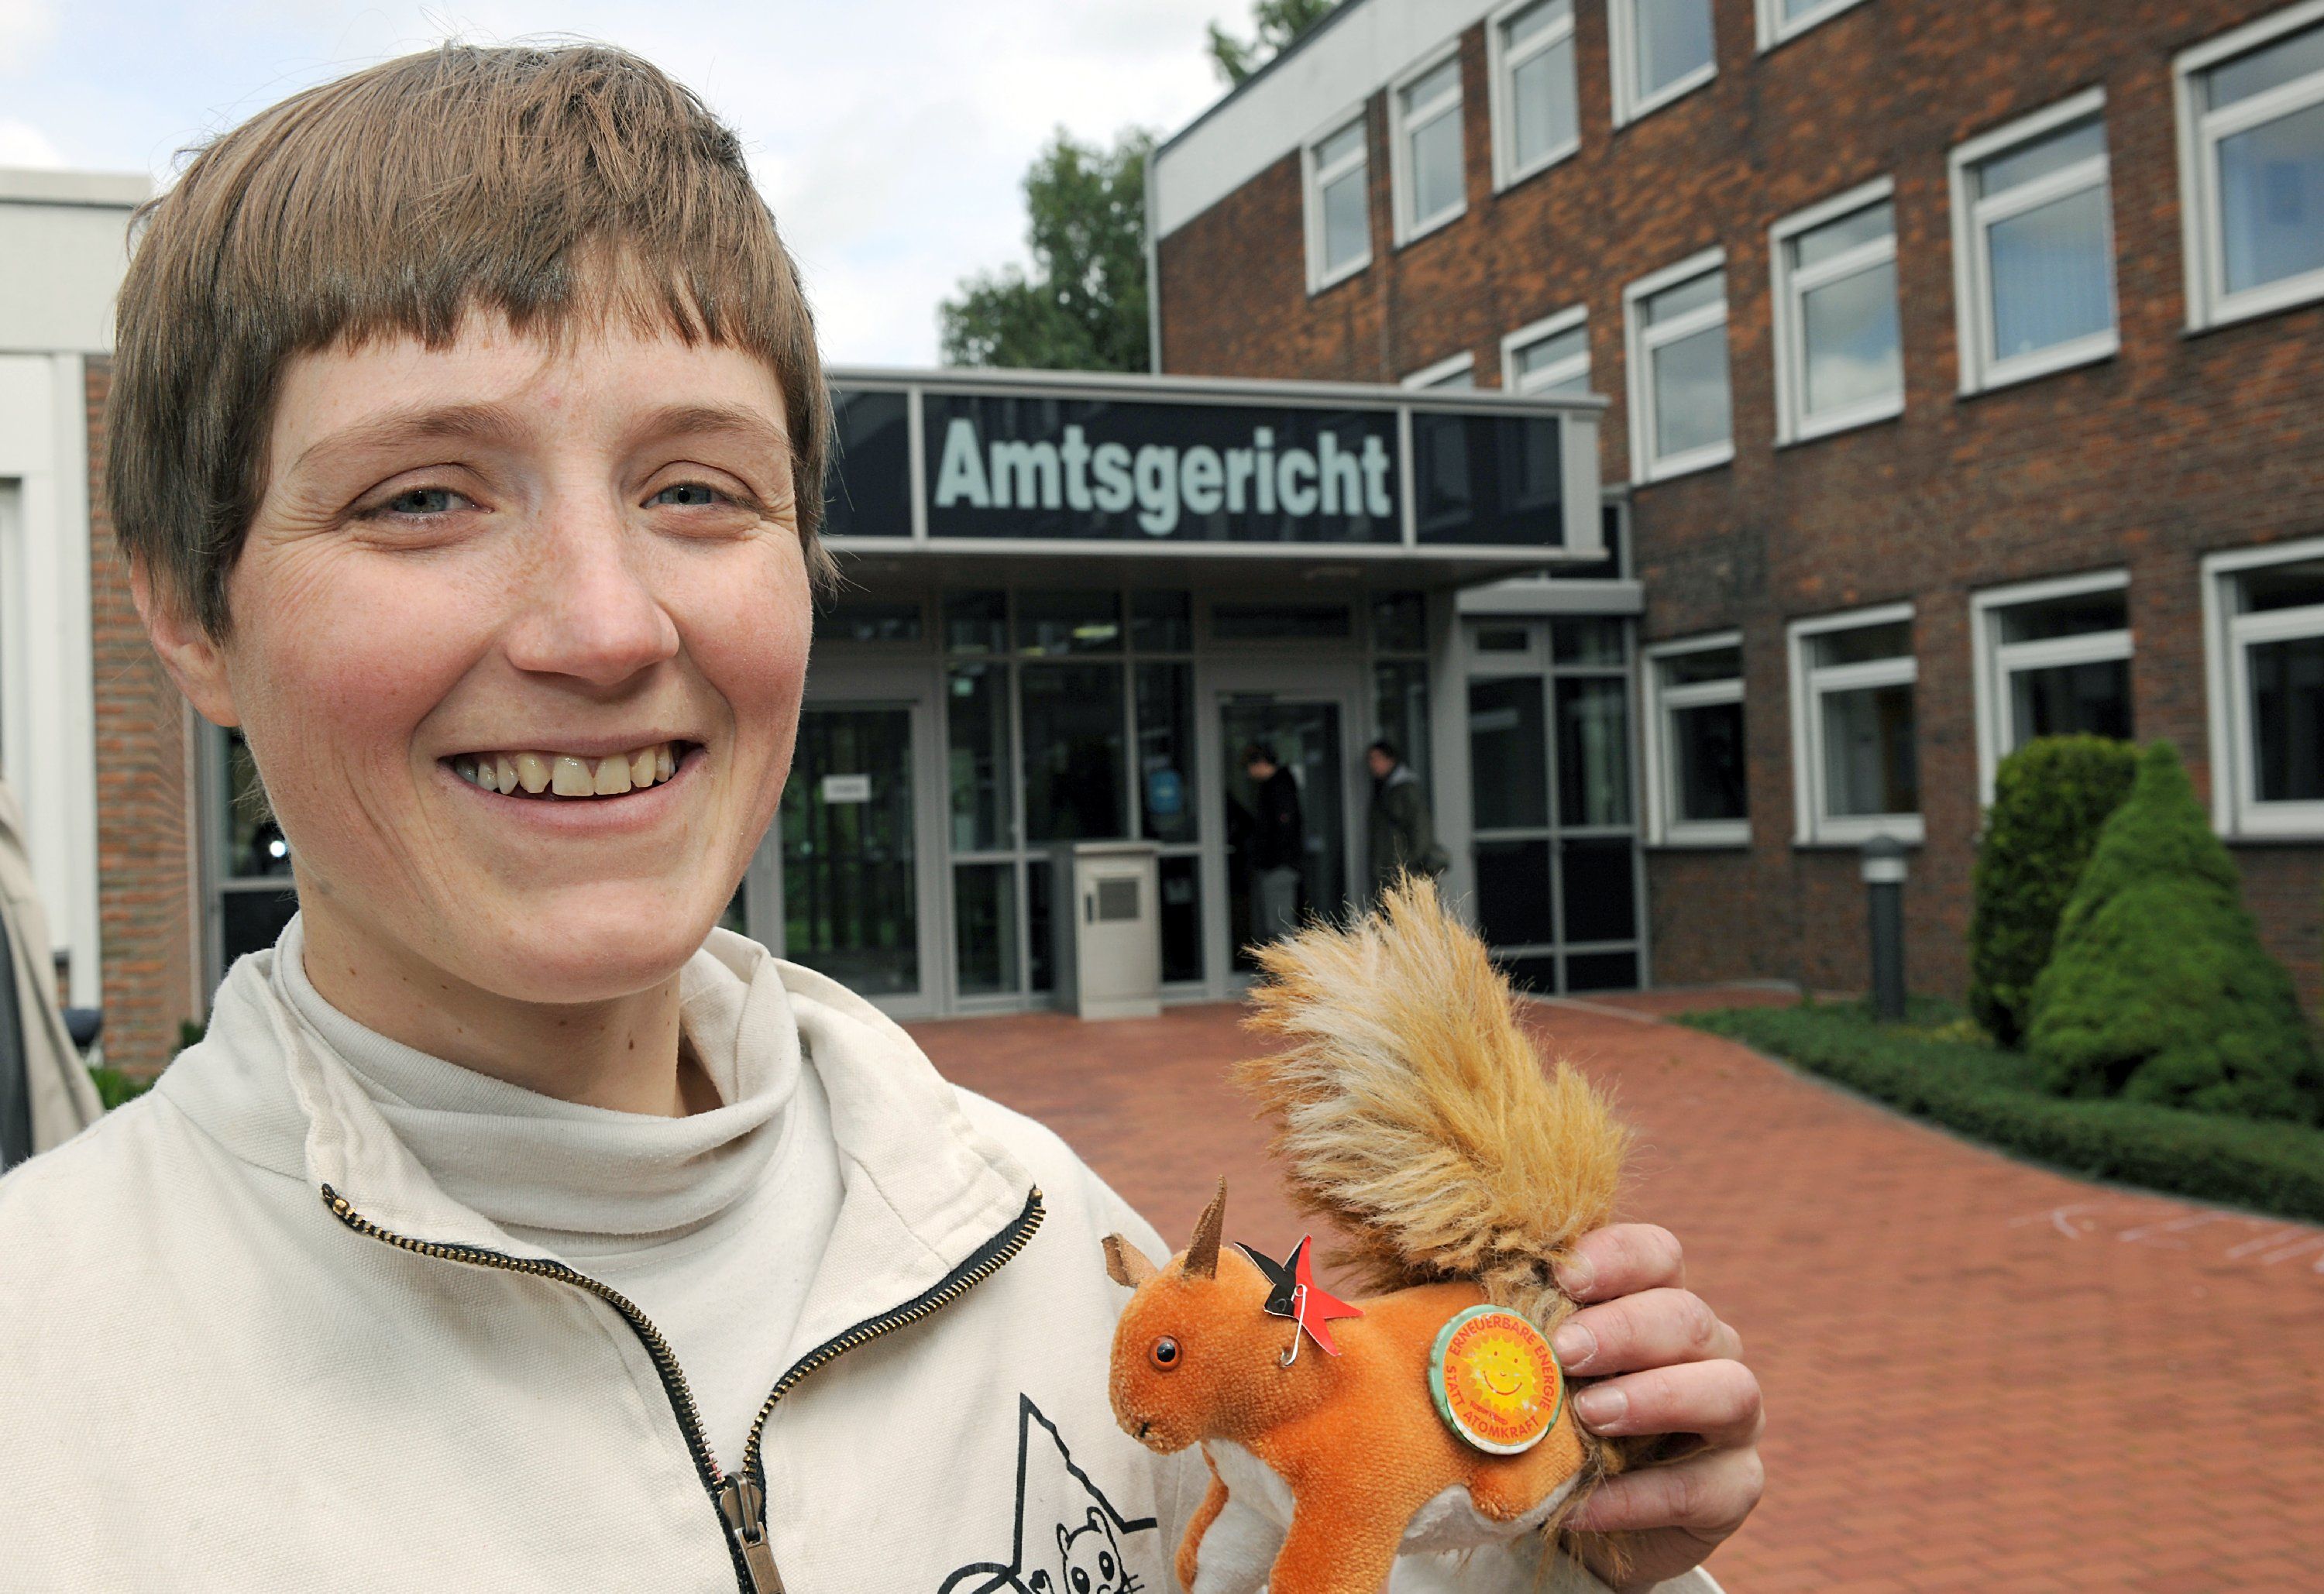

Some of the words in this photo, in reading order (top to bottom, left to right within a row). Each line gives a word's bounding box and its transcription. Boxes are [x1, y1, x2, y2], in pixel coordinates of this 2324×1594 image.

[935, 418, 1391, 535] Amtsgericht
[1446, 1366, 1465, 1407] STATT
[1463, 1410, 1539, 1439] ATOMKRAFT
[1449, 1316, 1536, 1355] ERNEUERBARE
[1534, 1345, 1555, 1411] ENERGIE
